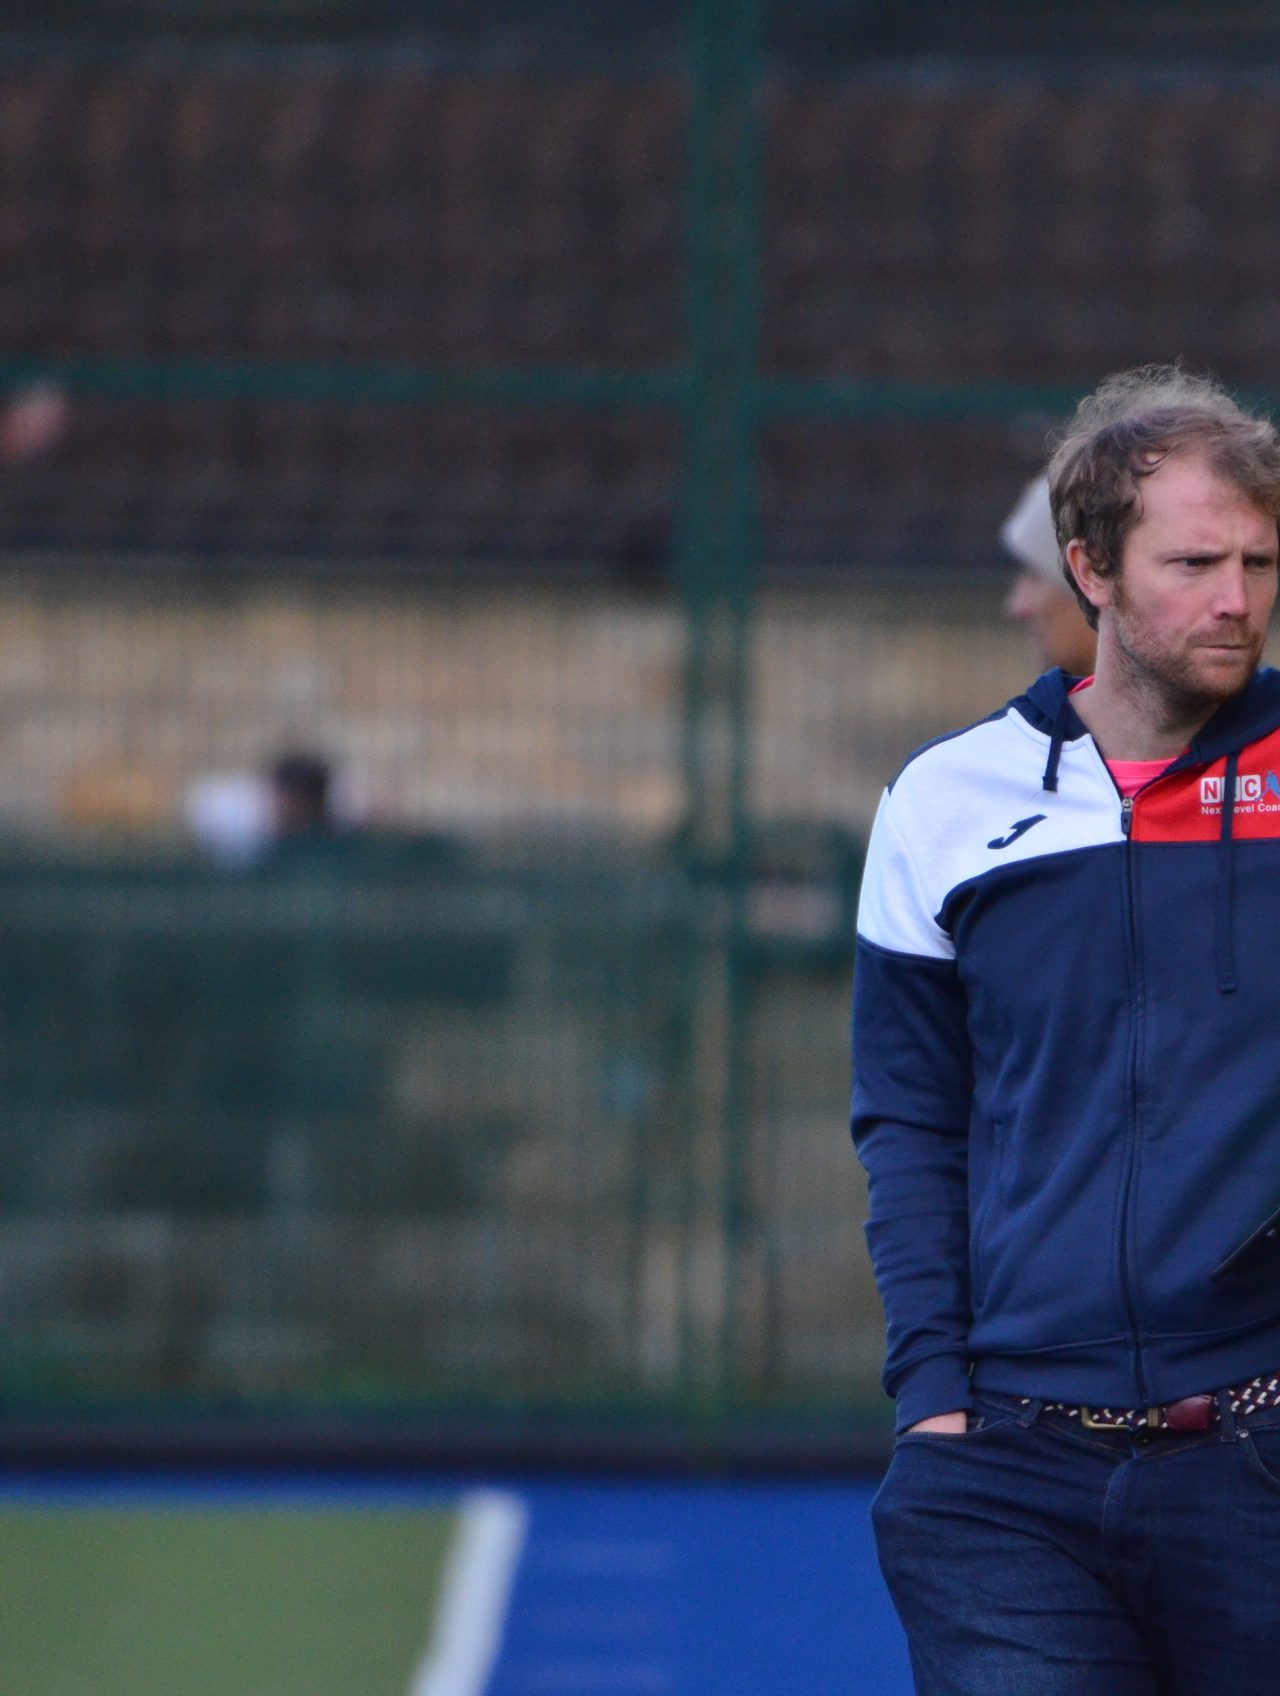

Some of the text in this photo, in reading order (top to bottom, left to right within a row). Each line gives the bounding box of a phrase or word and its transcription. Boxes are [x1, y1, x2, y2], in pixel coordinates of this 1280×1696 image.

[1202, 775, 1261, 803] NC
[1201, 806, 1224, 815] Nex
[1233, 804, 1255, 814] evel
